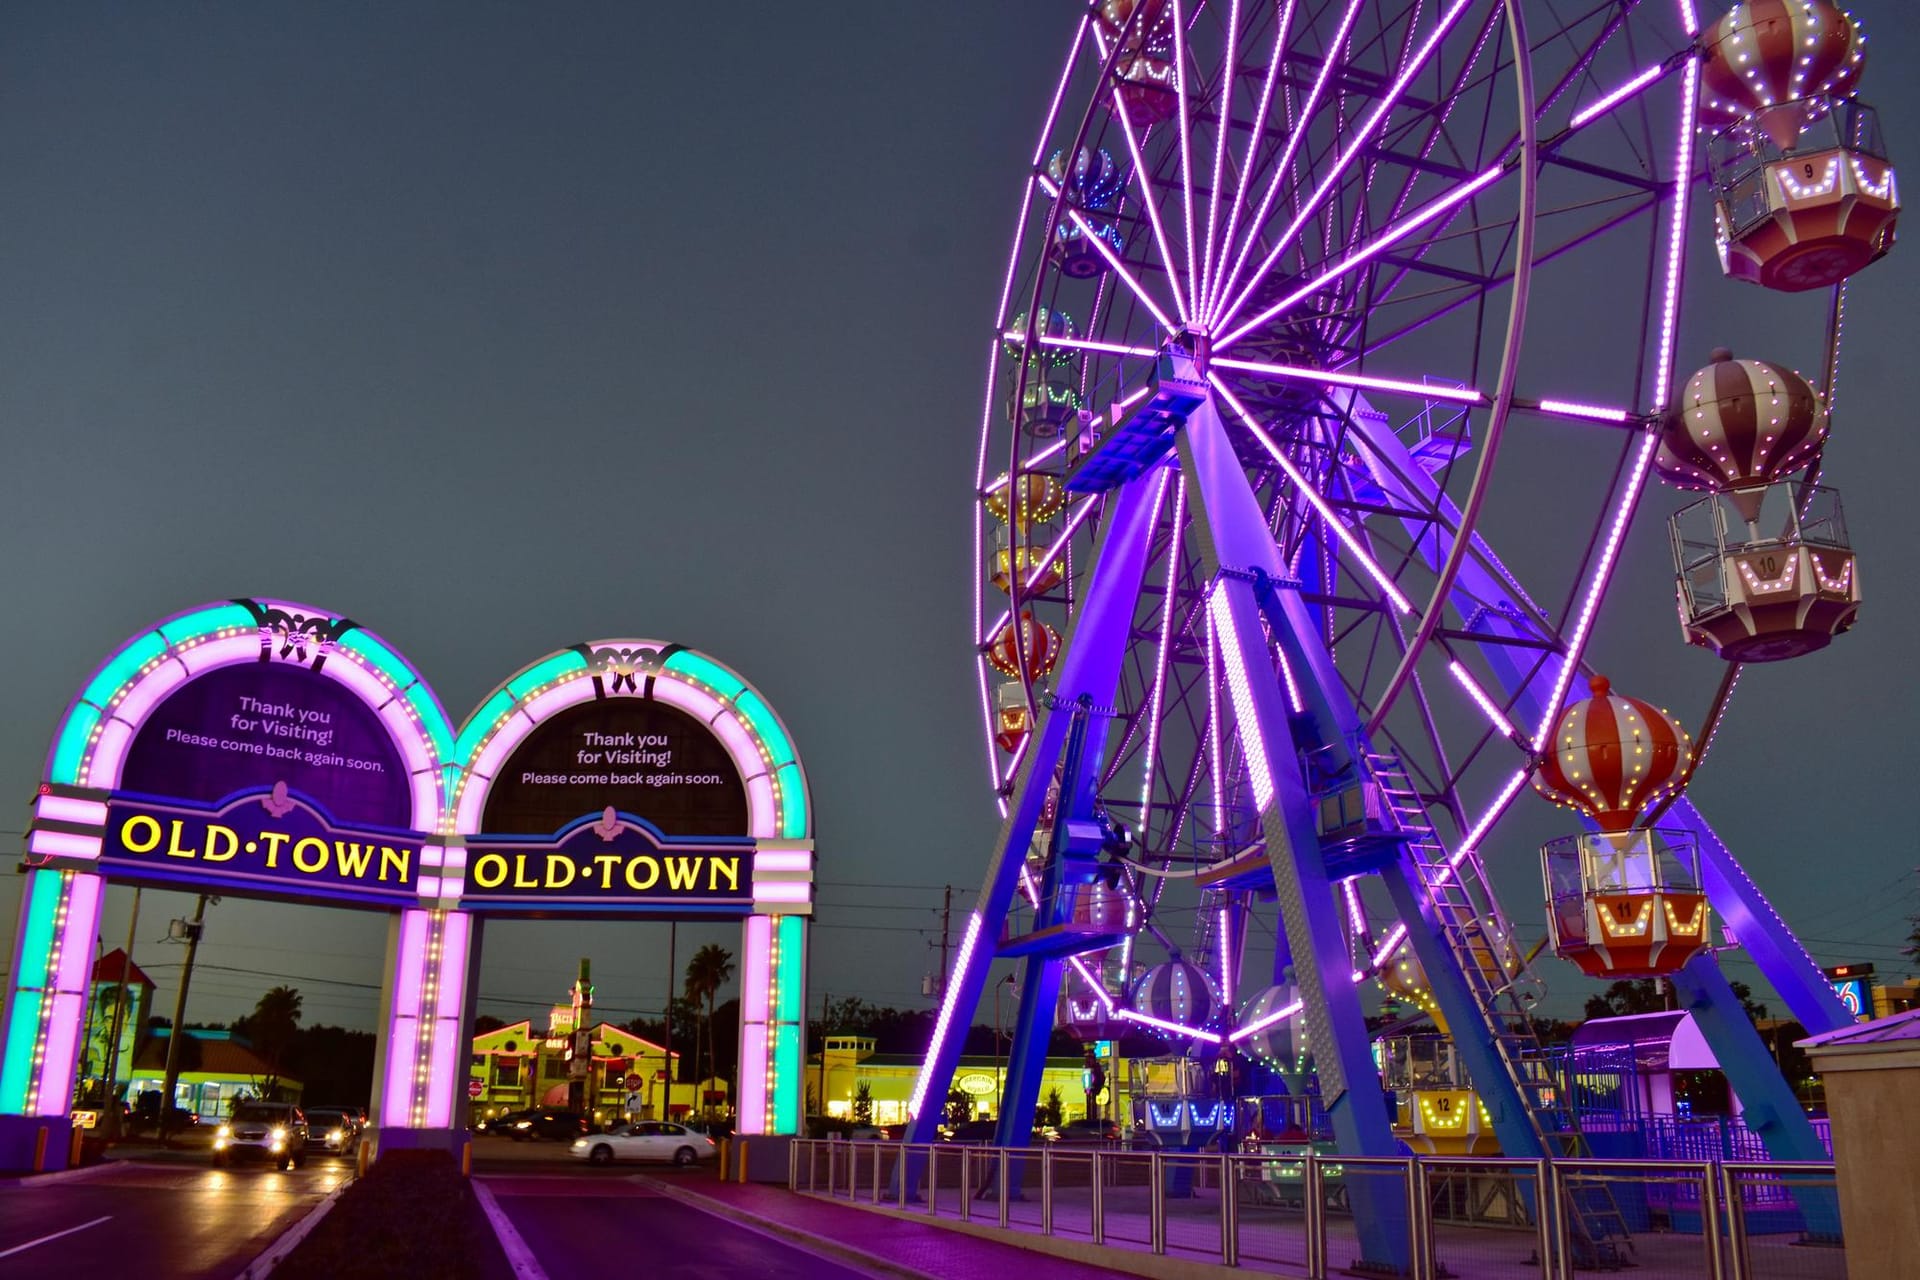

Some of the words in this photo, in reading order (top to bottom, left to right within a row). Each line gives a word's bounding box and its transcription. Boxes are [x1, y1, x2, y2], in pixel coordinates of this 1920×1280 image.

[1804, 163, 1814, 179] 9
[1760, 556, 1776, 573] 10
[239, 696, 295, 719] Thank
[298, 708, 331, 724] you
[231, 714, 259, 731] for
[262, 719, 333, 746] Visiting!
[583, 731, 634, 746] Thank
[637, 735, 668, 749] you
[166, 729, 218, 748] Please
[220, 740, 263, 754] come
[266, 743, 302, 760] back
[304, 752, 344, 767] again
[346, 758, 385, 773] soon.
[577, 750, 602, 764] for
[605, 750, 672, 767] Visiting!
[522, 772, 568, 784] Please
[569, 775, 608, 784] come
[610, 772, 644, 784] back
[646, 772, 683, 787] again
[685, 774, 724, 784] soon.
[1617, 902, 1632, 918] 11
[626, 1078, 642, 1087] STOP
[1437, 1097, 1450, 1112] 12
